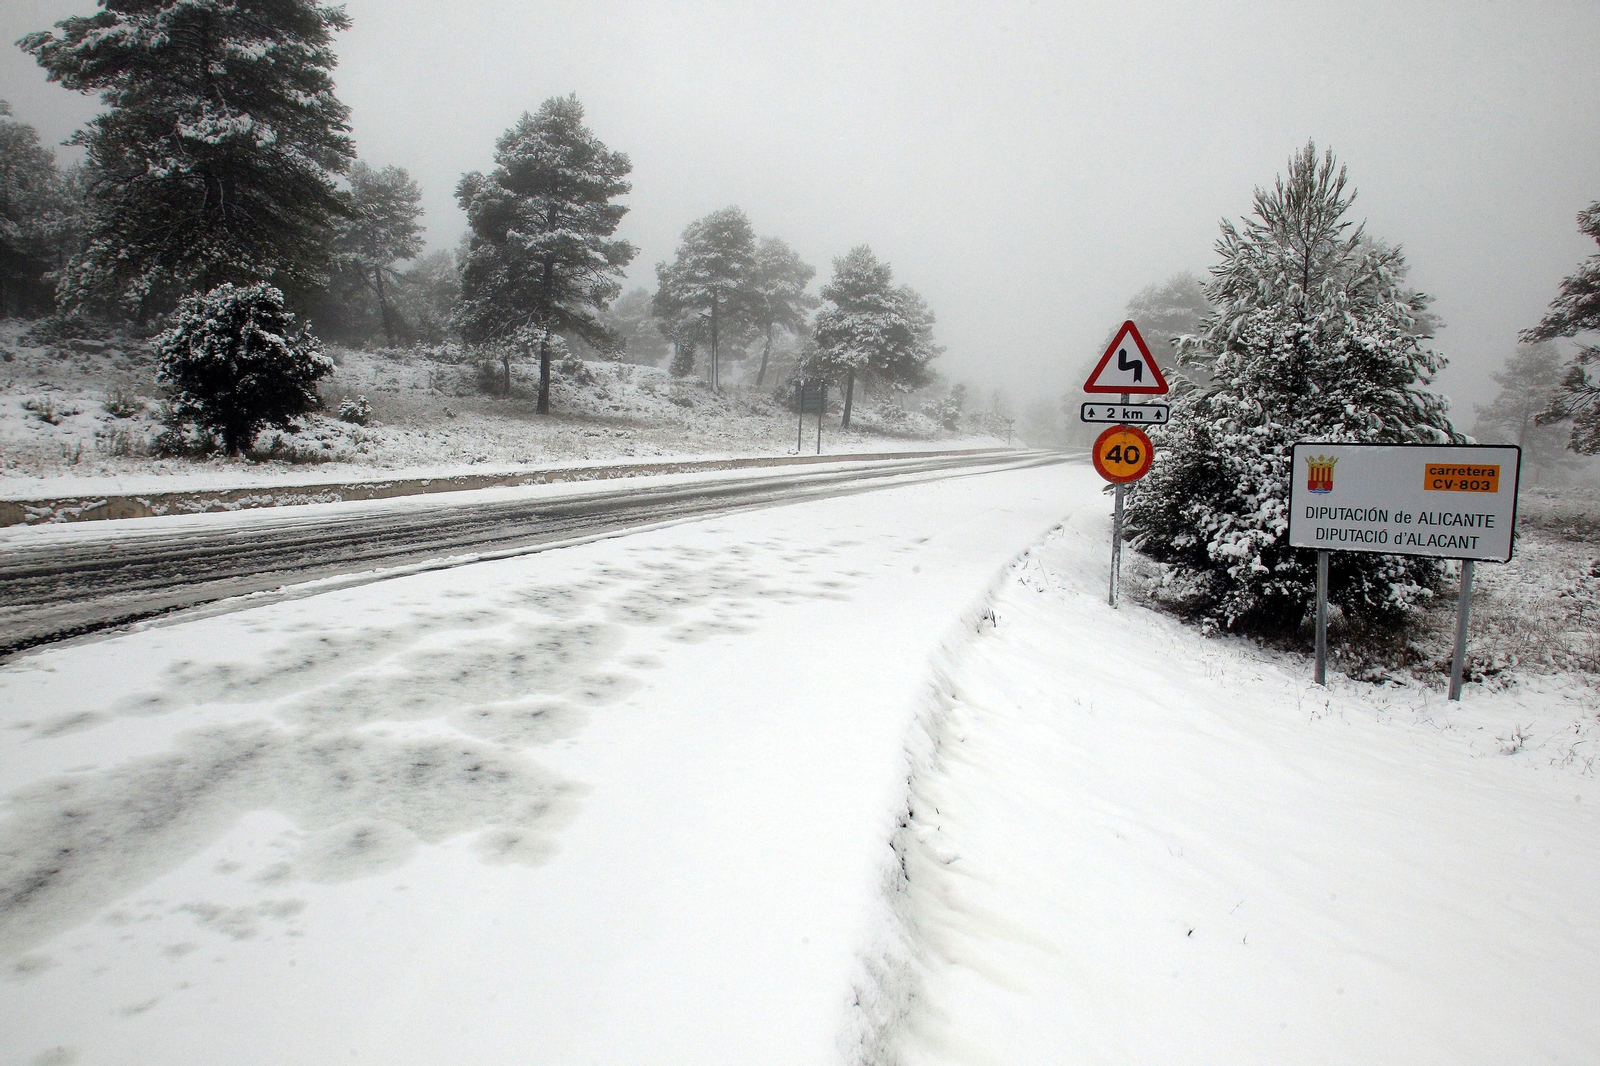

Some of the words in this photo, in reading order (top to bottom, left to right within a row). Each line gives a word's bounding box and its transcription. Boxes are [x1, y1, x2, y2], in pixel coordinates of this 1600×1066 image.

[1106, 407, 1115, 419] 2
[1122, 408, 1143, 419] km
[1105, 445, 1140, 465] 40
[1429, 466, 1496, 477] carretera
[1433, 479, 1491, 491] CV-803
[1305, 506, 1388, 523] DIPUTACIÓN
[1394, 510, 1412, 524] de
[1418, 511, 1495, 528] ALICANTE
[1316, 527, 1388, 544] DIPUTACIÓ
[1394, 532, 1480, 549] d'ALACANT
